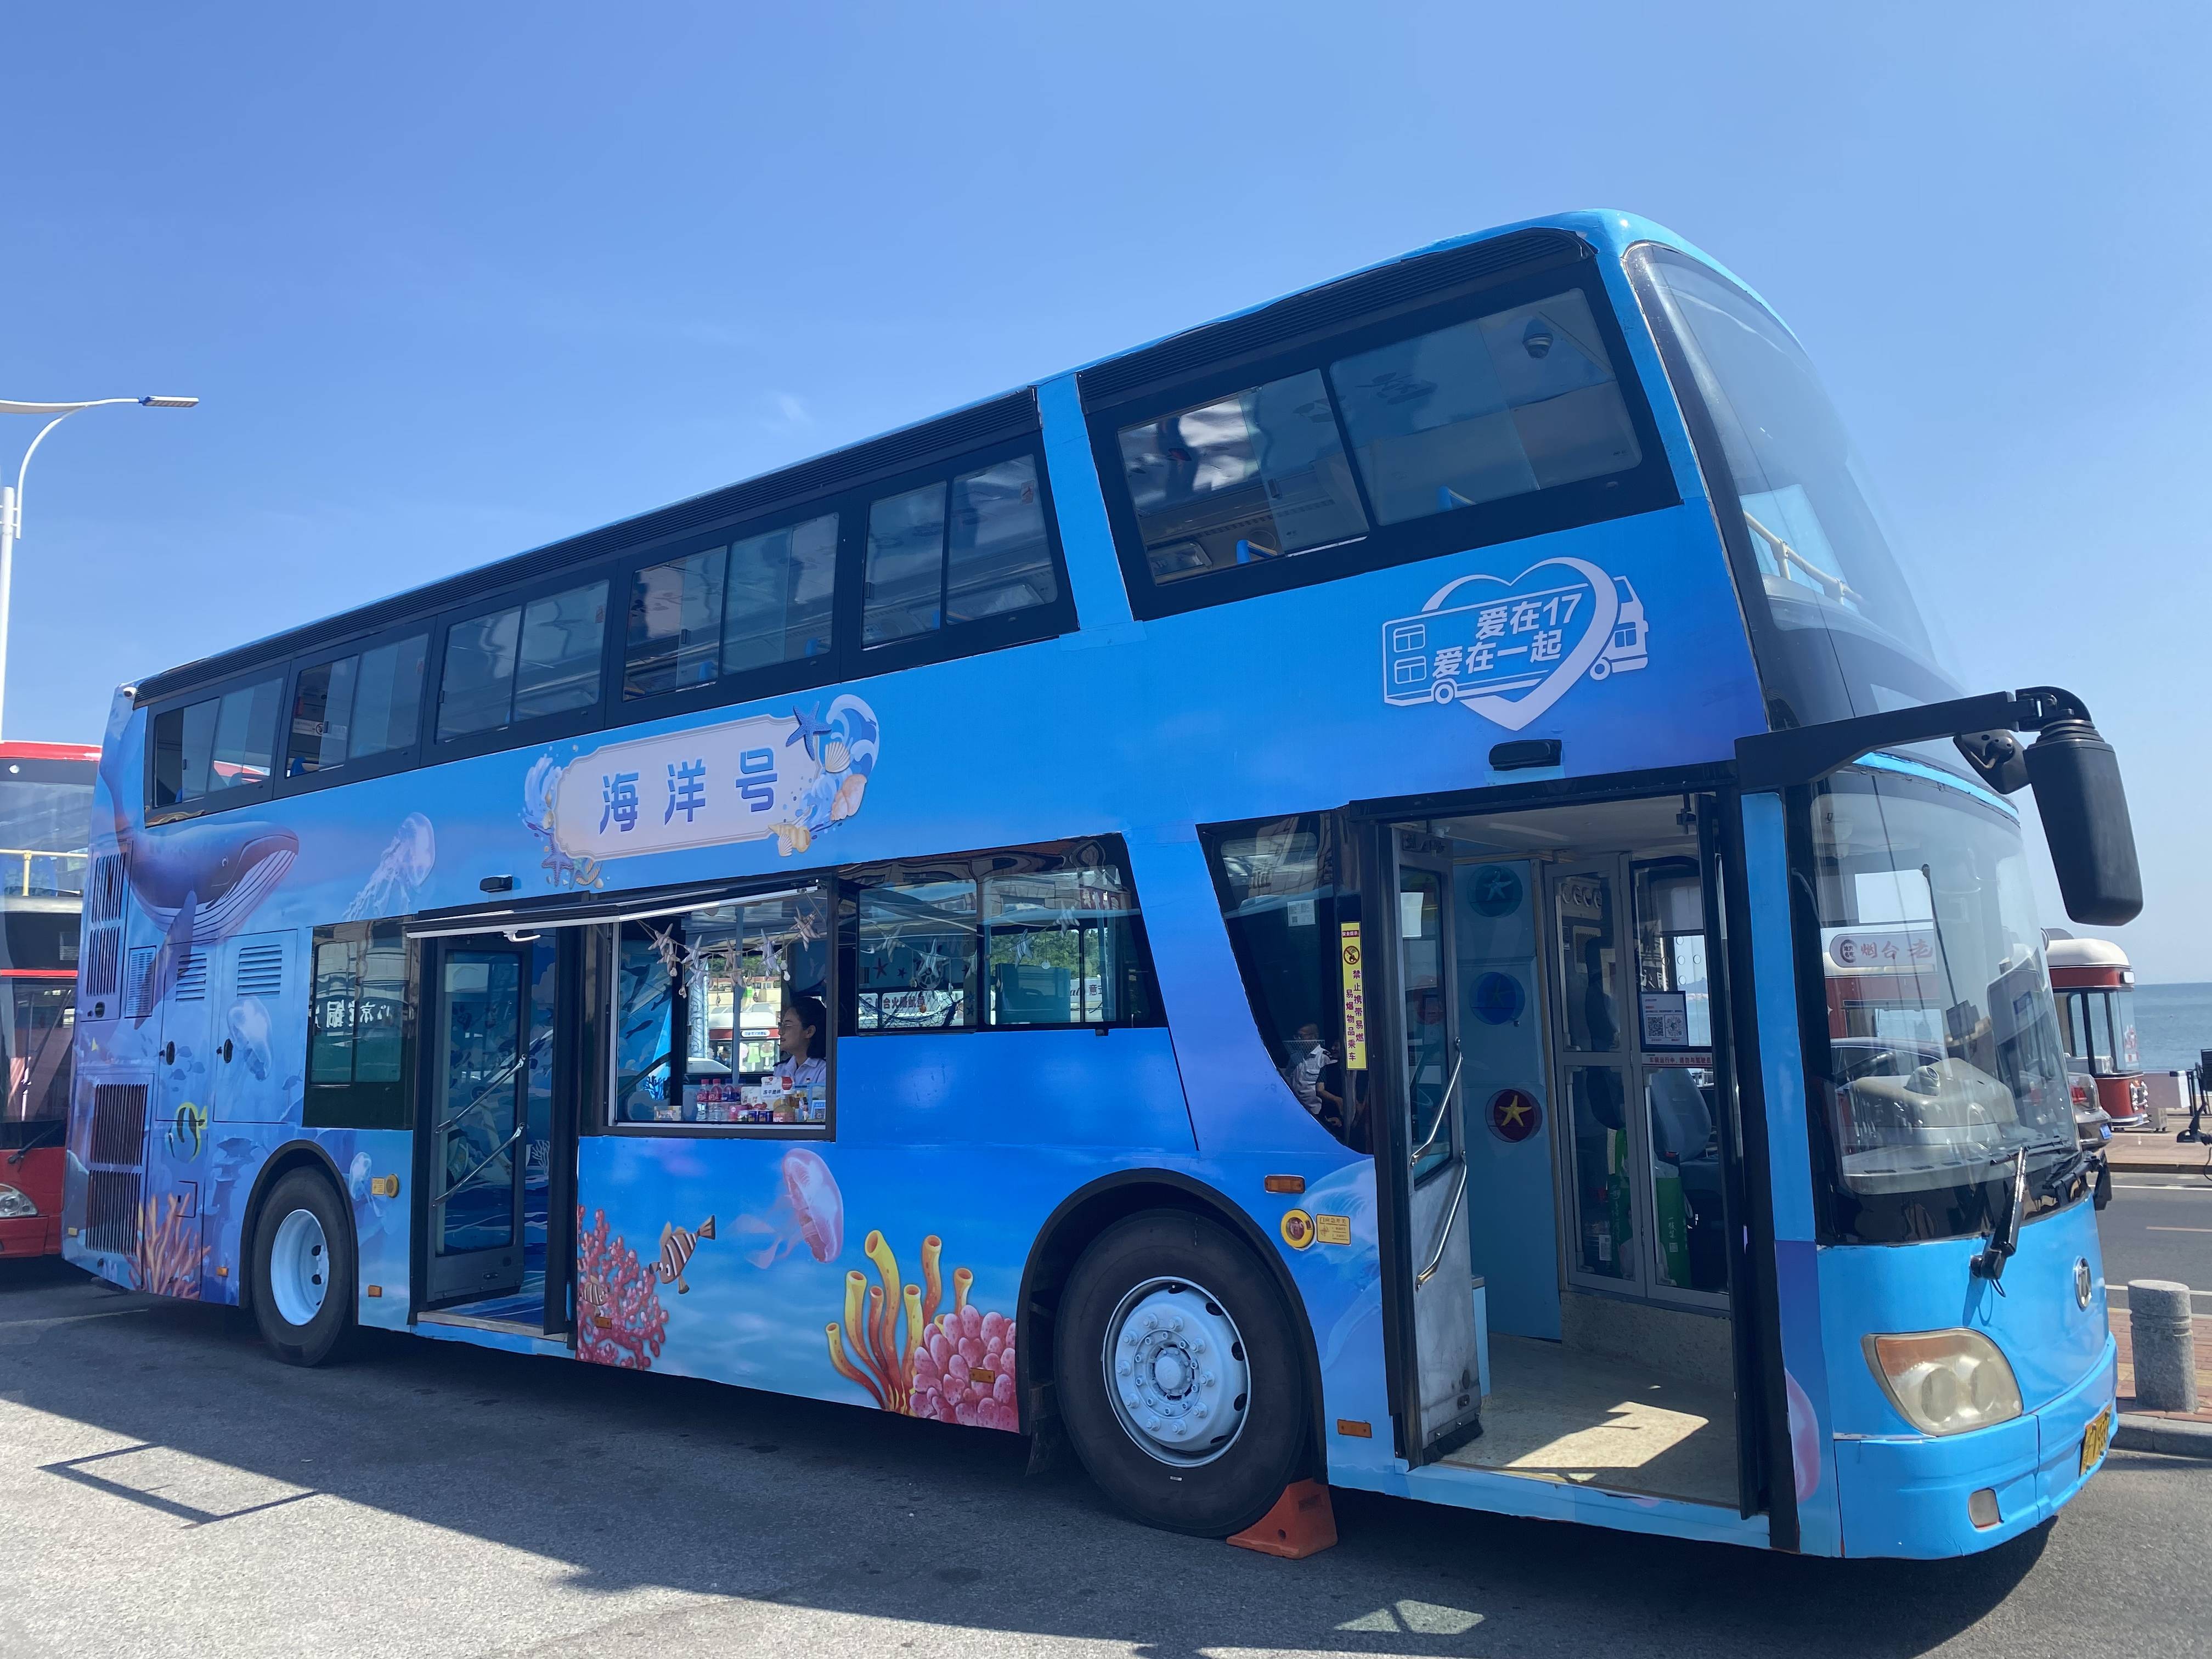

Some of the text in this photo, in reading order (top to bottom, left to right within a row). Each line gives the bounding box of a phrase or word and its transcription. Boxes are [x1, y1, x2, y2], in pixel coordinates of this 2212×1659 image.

[1475, 593, 1582, 640] 爱在17
[1432, 629, 1562, 678] 爱在一起
[599, 748, 778, 834] 海洋号
[875, 995, 926, 1009] 台火爆鱿鱼
[1346, 989, 1357, 1062] 易爆物品乘车
[1352, 969, 1364, 1042] 禁止携带易燃
